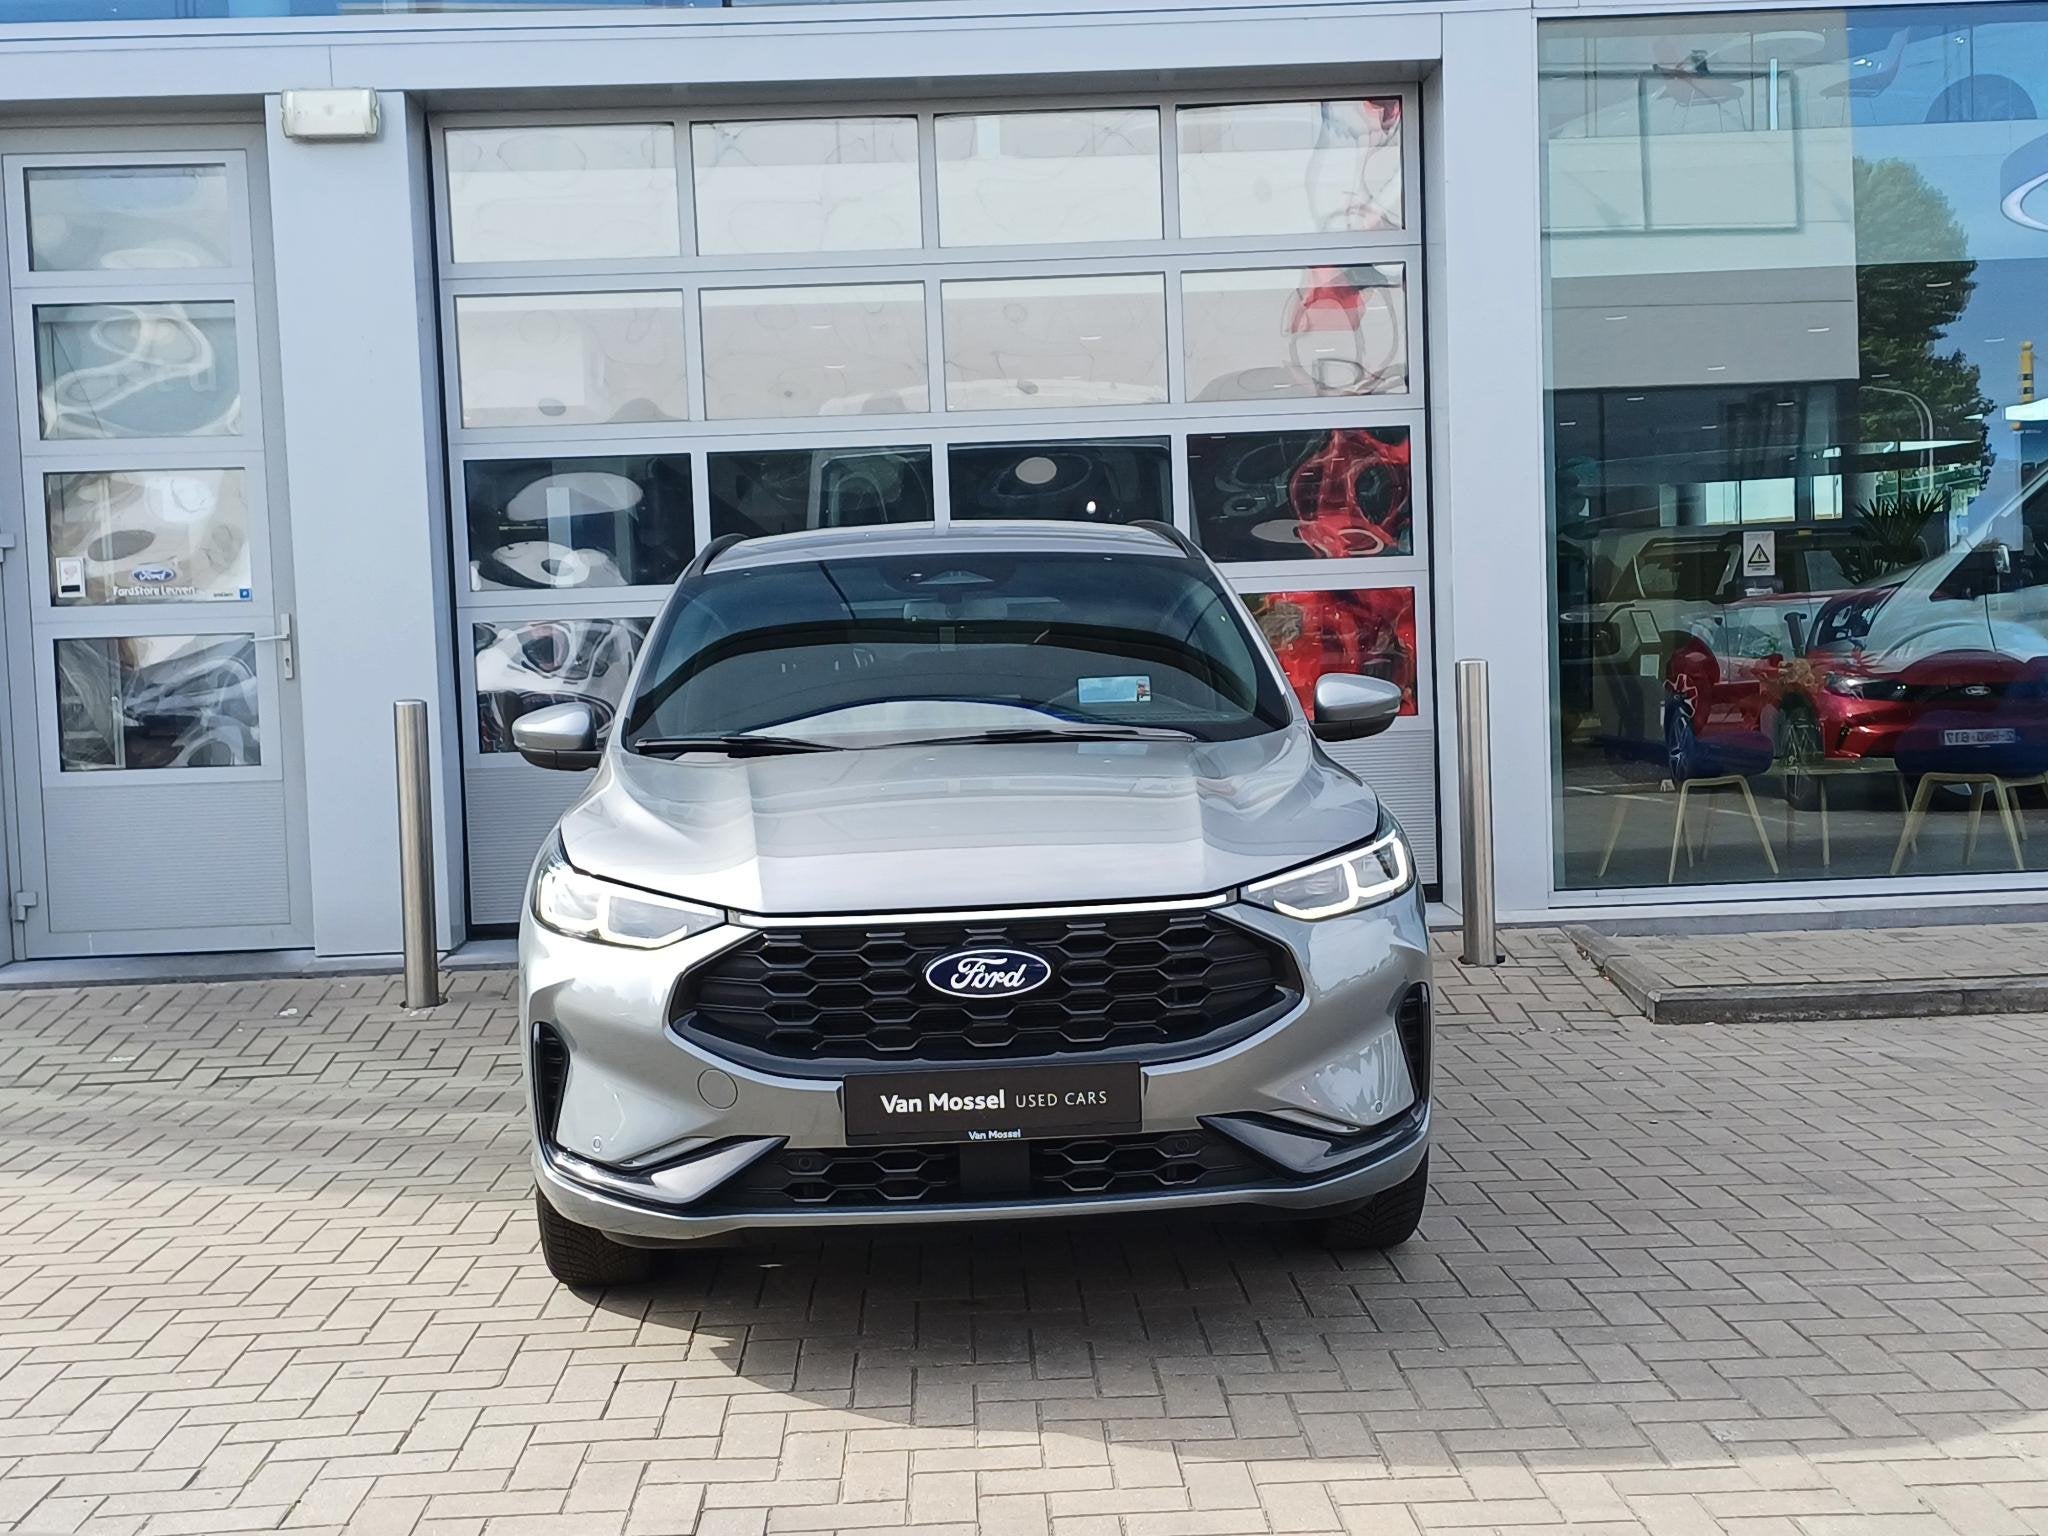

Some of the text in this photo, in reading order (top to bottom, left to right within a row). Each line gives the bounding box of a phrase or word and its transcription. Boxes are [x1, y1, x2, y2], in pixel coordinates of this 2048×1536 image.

[950, 957, 1027, 989] Ford
[880, 1088, 1107, 1114] Van Mossel USED CARS
[968, 1128, 1022, 1141] Van Mossel
